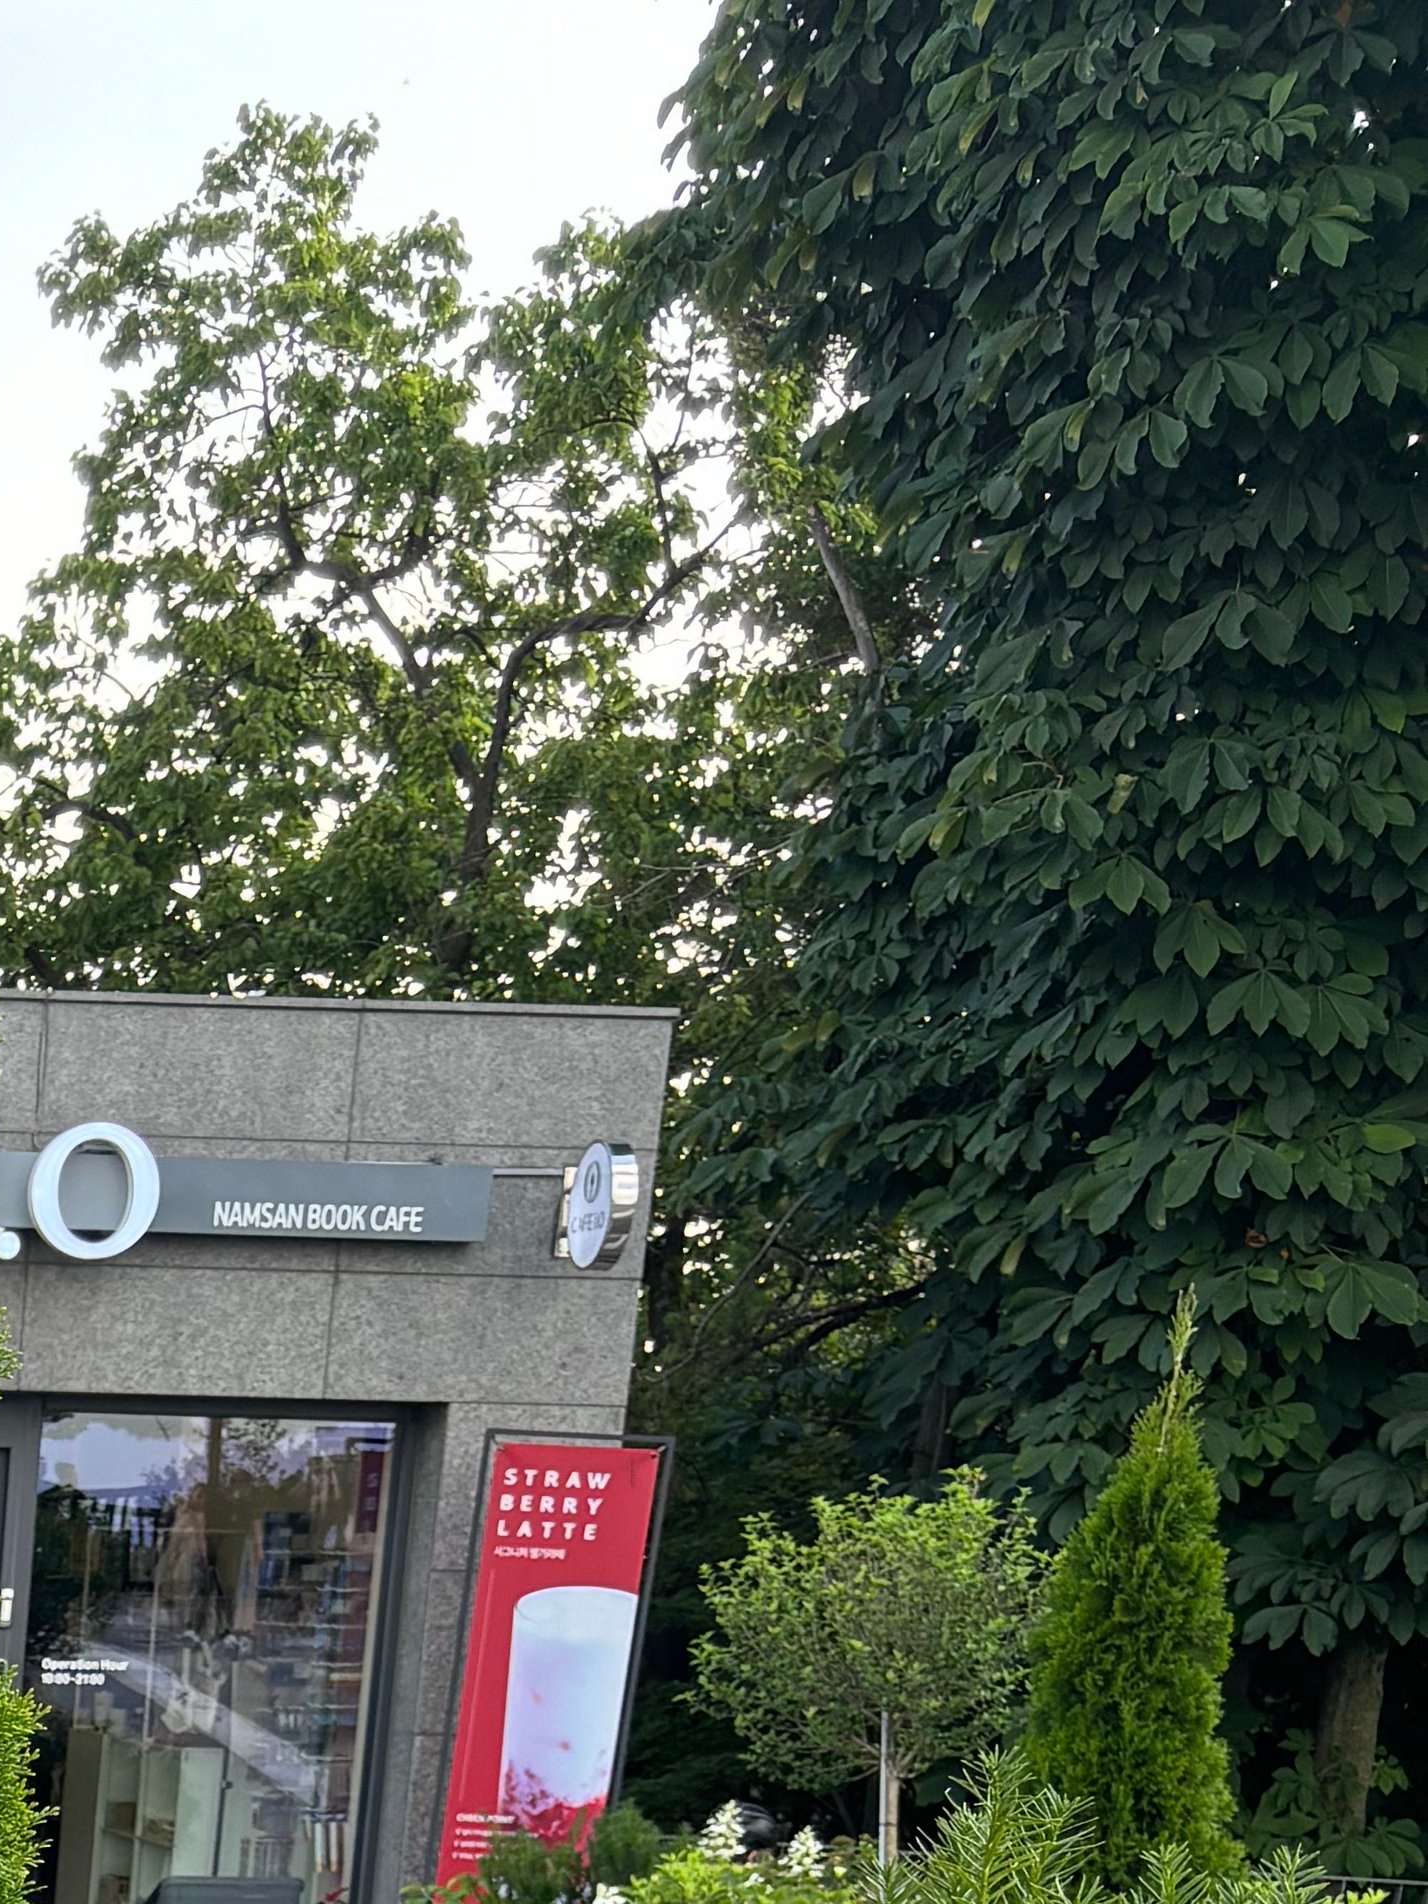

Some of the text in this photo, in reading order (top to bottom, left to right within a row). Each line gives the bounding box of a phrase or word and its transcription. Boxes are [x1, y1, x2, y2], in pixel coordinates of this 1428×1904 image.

[213, 1200, 424, 1234] NAMSAN BOOK CAFE
[503, 1468, 612, 1491] STRAW
[499, 1496, 604, 1517] BERRY
[497, 1520, 598, 1542] LATTE
